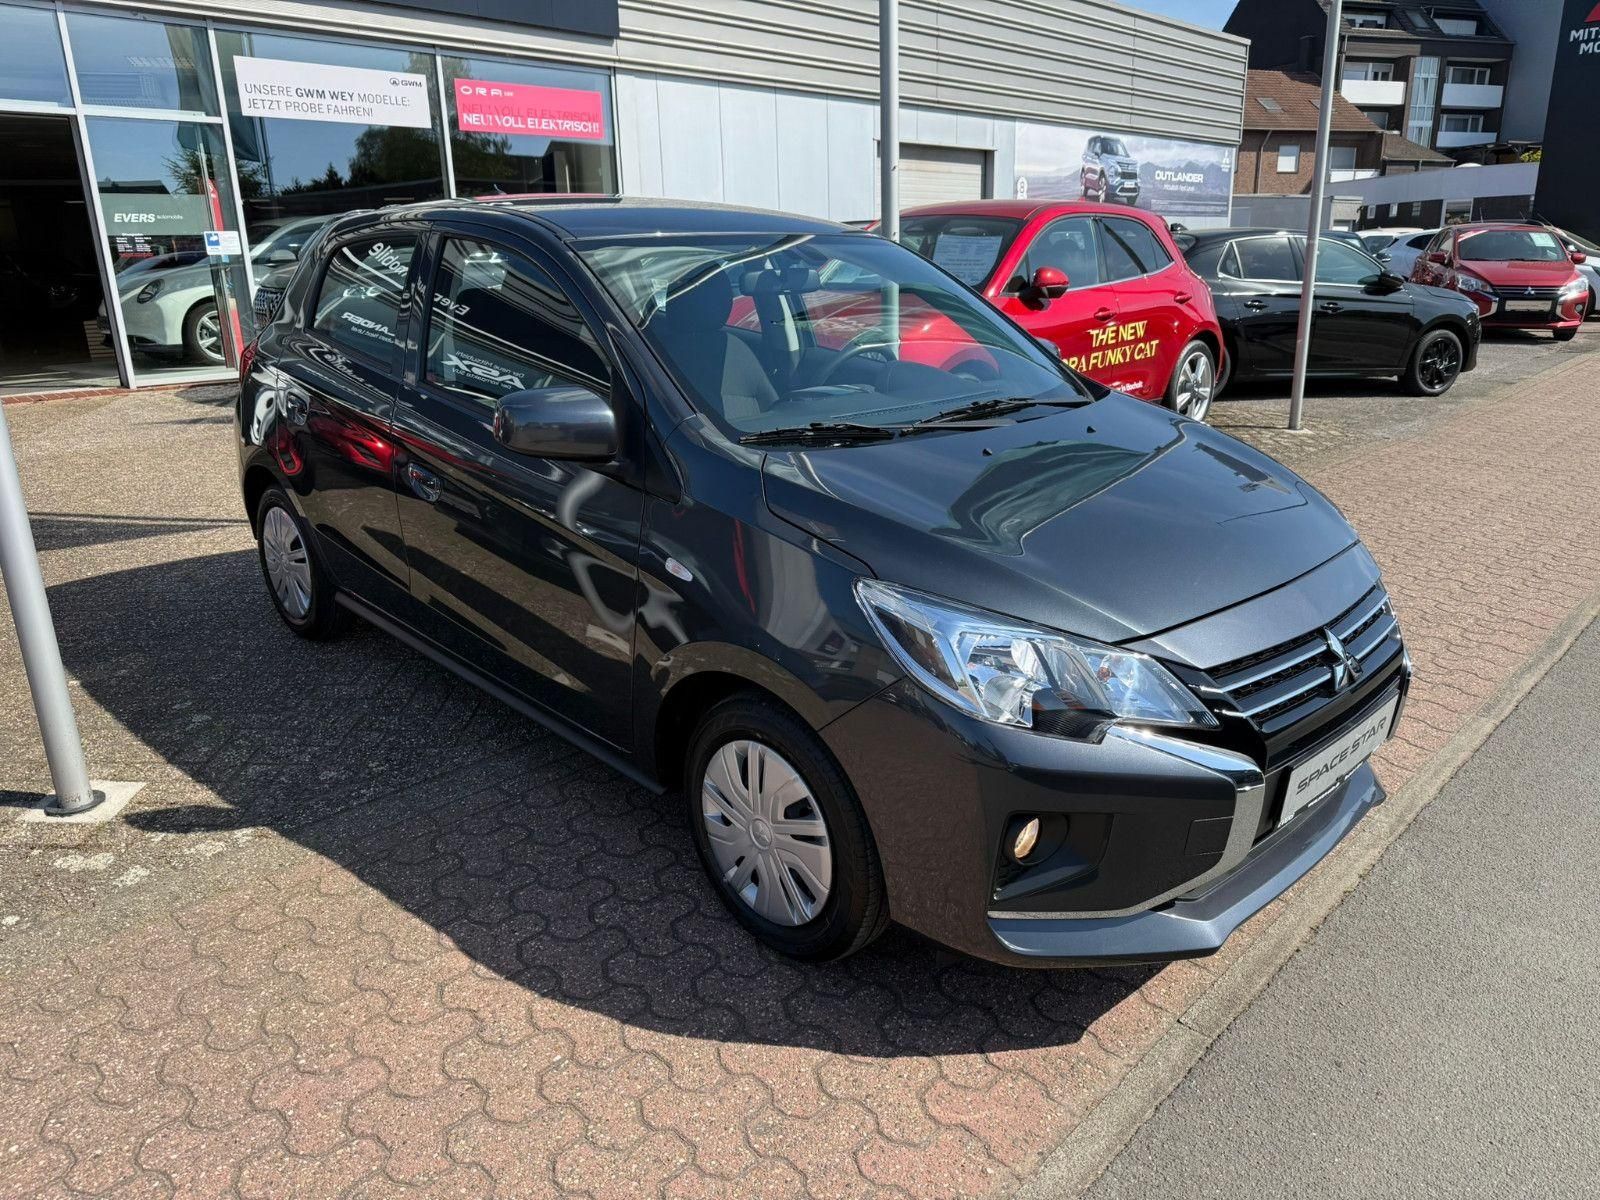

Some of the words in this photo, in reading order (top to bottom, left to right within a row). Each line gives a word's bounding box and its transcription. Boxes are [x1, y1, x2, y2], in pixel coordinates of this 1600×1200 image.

[1570, 26, 1600, 42] MIT
[401, 79, 423, 88] GWM
[244, 83, 293, 97] UNSERE
[295, 87, 326, 100] GWM
[328, 90, 354, 102] WEY
[357, 92, 411, 107] MODELLE:
[247, 98, 282, 111] JETZT
[285, 101, 325, 114] PROBE
[327, 104, 374, 118] FAHREN!
[462, 113, 493, 126] NEU!
[494, 115, 527, 129] VOLL
[527, 117, 599, 133] ELEKTRISCH!
[1154, 170, 1204, 183] OUTLANDER
[114, 213, 156, 223] EVERS
[1089, 326, 1117, 348] THE
[1118, 320, 1148, 343] NEW
[1088, 344, 1135, 371] FUNKY
[1134, 340, 1159, 361] CAT
[1296, 746, 1350, 795] SPACE
[1350, 716, 1387, 755] STAR
